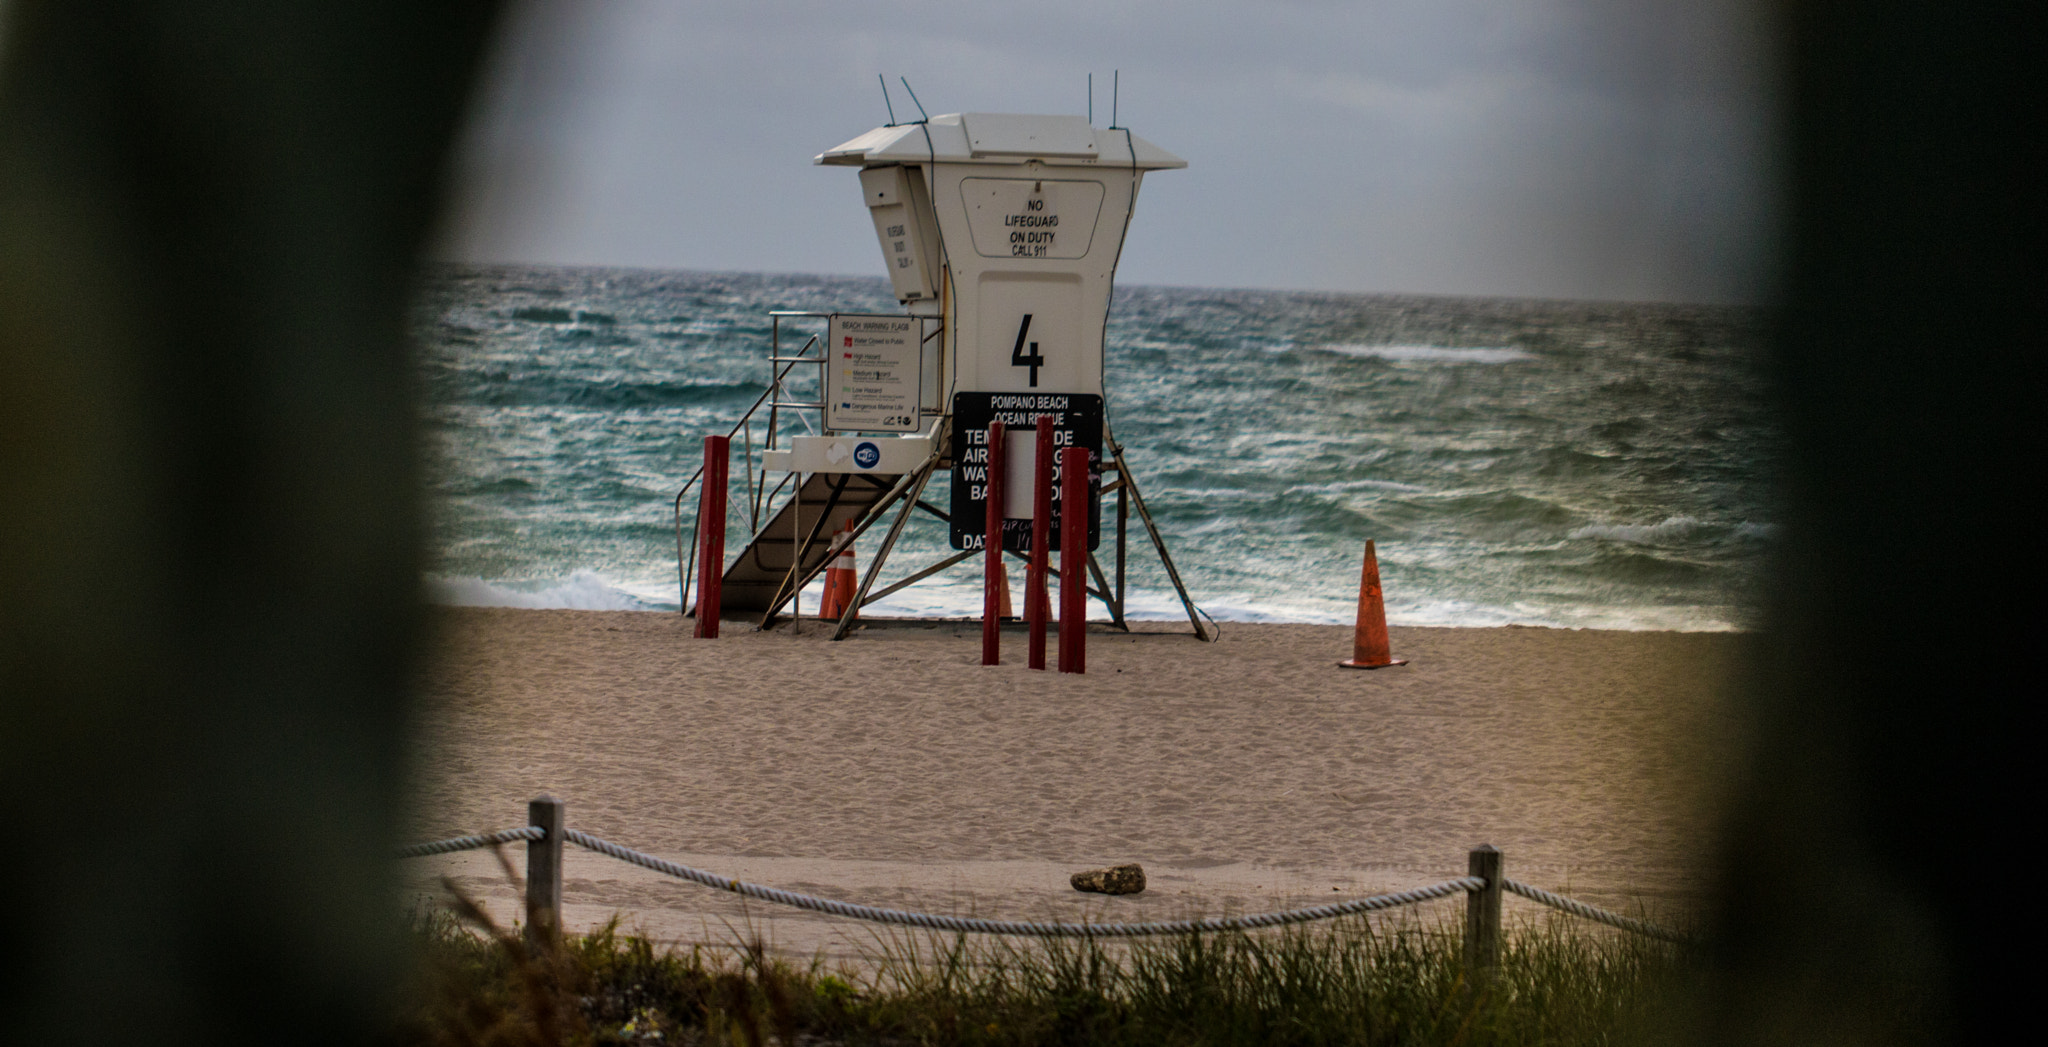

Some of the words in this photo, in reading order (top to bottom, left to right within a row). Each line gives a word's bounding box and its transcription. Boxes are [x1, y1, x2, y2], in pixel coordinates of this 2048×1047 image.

[1028, 200, 1043, 211] NO
[1005, 215, 1059, 227] LIFEGUARD
[1009, 231, 1025, 243] ON
[1028, 232, 1055, 243] DUTY
[1012, 245, 1033, 256] CALL
[1034, 245, 1047, 256] 911
[842, 321, 861, 330] BEACH
[863, 321, 889, 331] WARNING
[891, 322, 909, 331] FLAGS
[1011, 313, 1044, 387] 4
[852, 403, 877, 411] Dangerous
[991, 396, 1036, 409] POMPANO
[1037, 397, 1069, 409] BEACH
[994, 412, 1026, 425] OCEAN
[1028, 412, 1065, 425] REUE
[1053, 430, 1074, 446] DE
[963, 448, 988, 463] AIR
